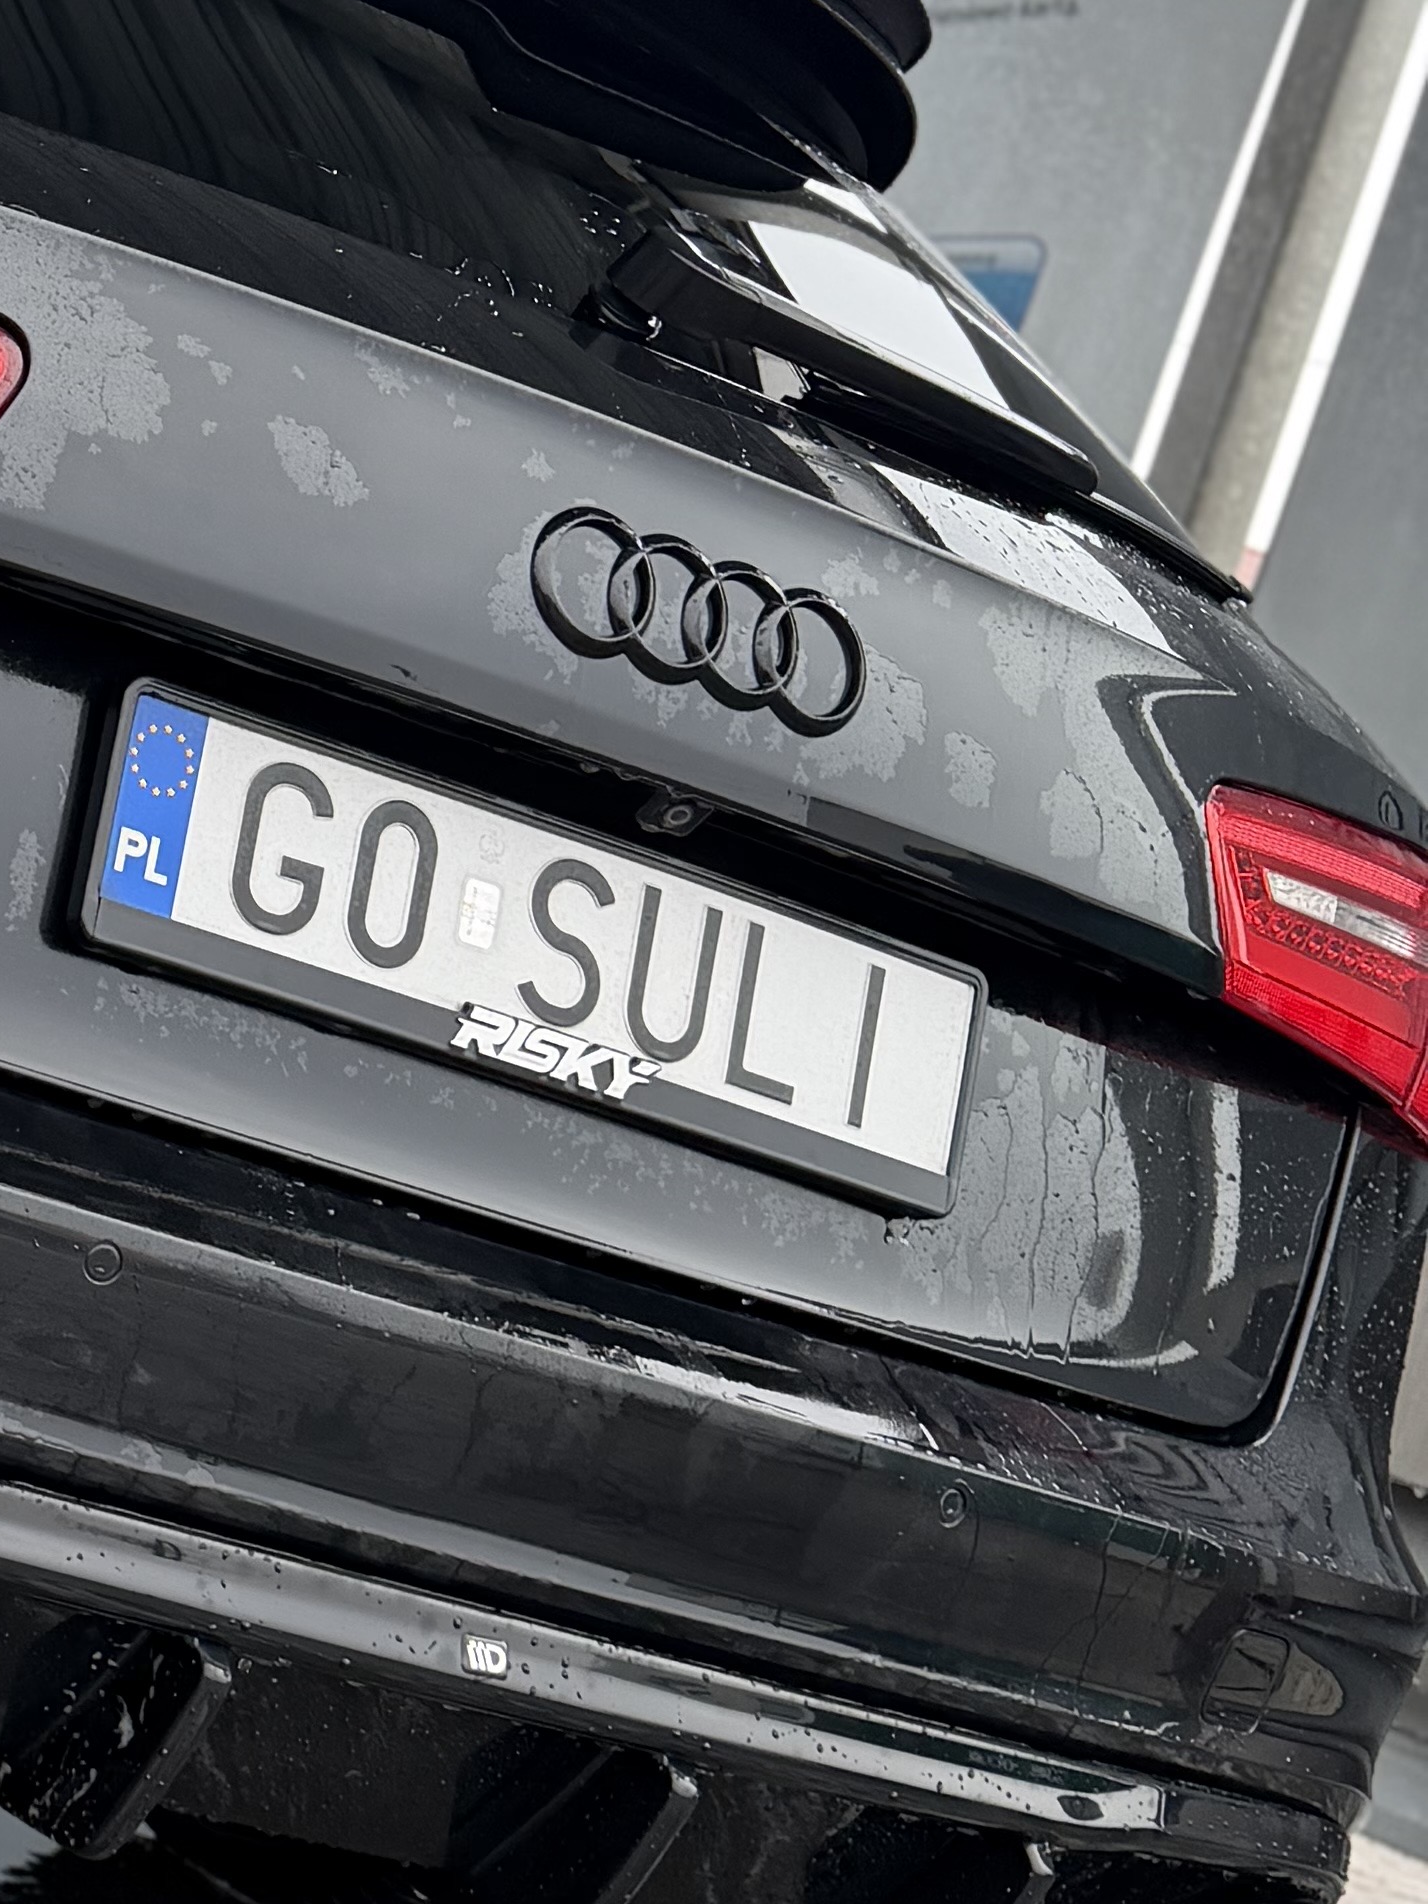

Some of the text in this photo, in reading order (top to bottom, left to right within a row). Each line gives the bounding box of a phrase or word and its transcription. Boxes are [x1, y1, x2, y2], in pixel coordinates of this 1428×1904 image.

[112, 826, 168, 887] PL
[516, 858, 887, 1129] SULI
[449, 1003, 663, 1100] RISKY
